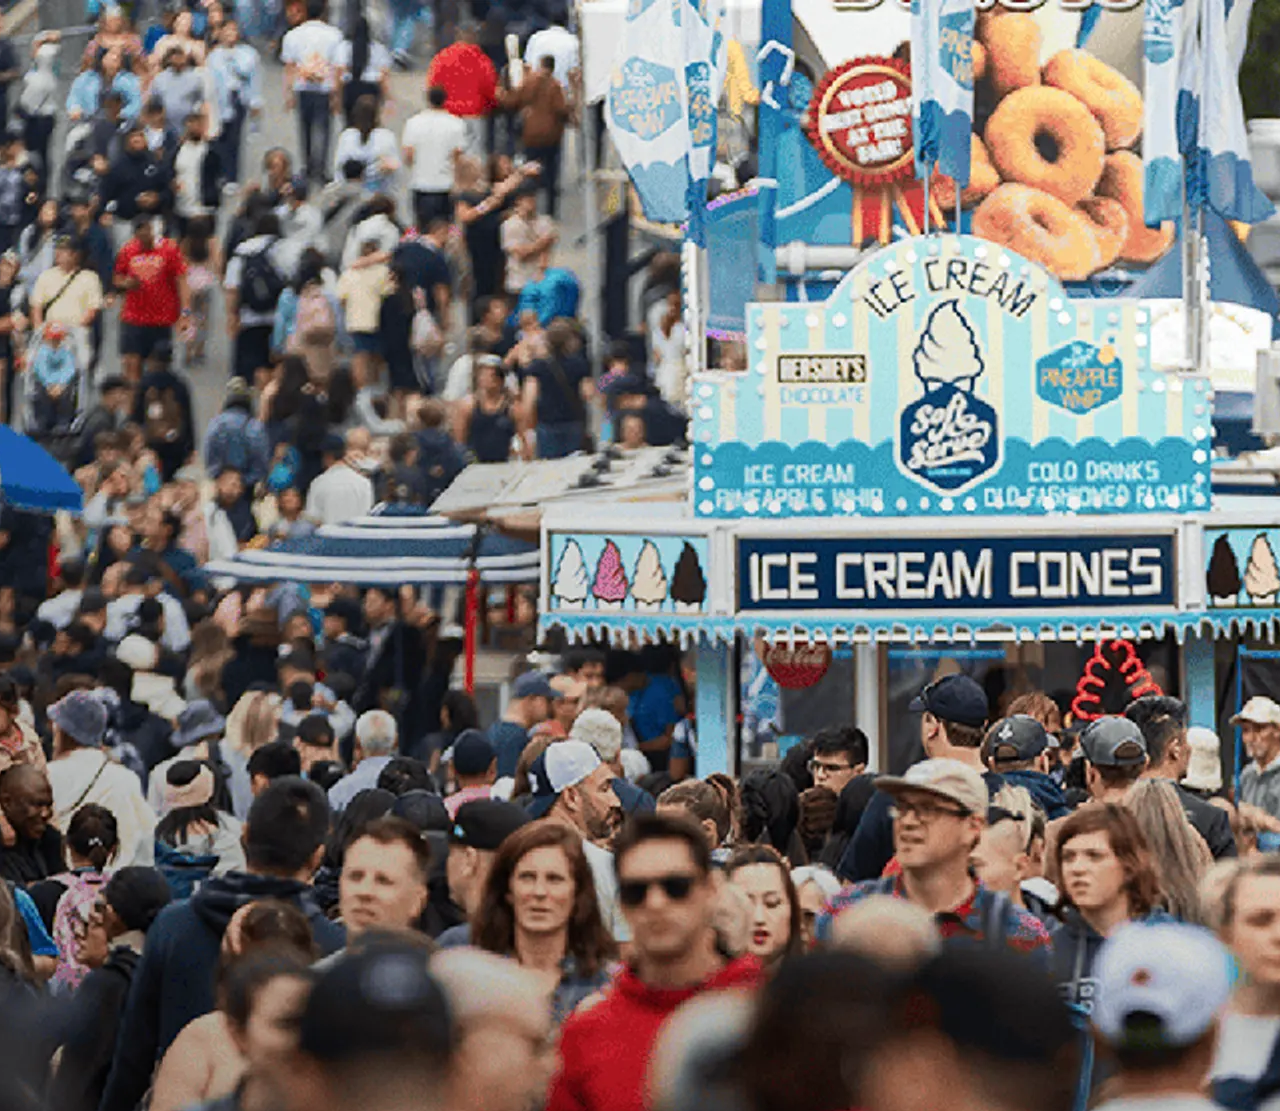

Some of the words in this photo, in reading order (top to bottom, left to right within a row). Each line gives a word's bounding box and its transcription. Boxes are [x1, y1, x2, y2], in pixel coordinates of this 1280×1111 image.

[864, 269, 915, 318] ICE
[924, 258, 1038, 318] CREAM
[780, 357, 864, 381] HERSHEY'S
[1040, 367, 1119, 387] PINEAPPLE
[780, 387, 866, 405] CHOCOLATE
[1059, 389, 1102, 408] WHIP
[910, 391, 978, 442] Soft
[907, 423, 992, 469] Serve
[744, 463, 776, 485] ICE
[783, 463, 855, 485] CREAM
[1028, 461, 1079, 483] COLD
[1085, 460, 1161, 482] DRINKS
[749, 551, 819, 602] ICE
[835, 547, 993, 600] CREAM
[1010, 546, 1162, 598] CONES
